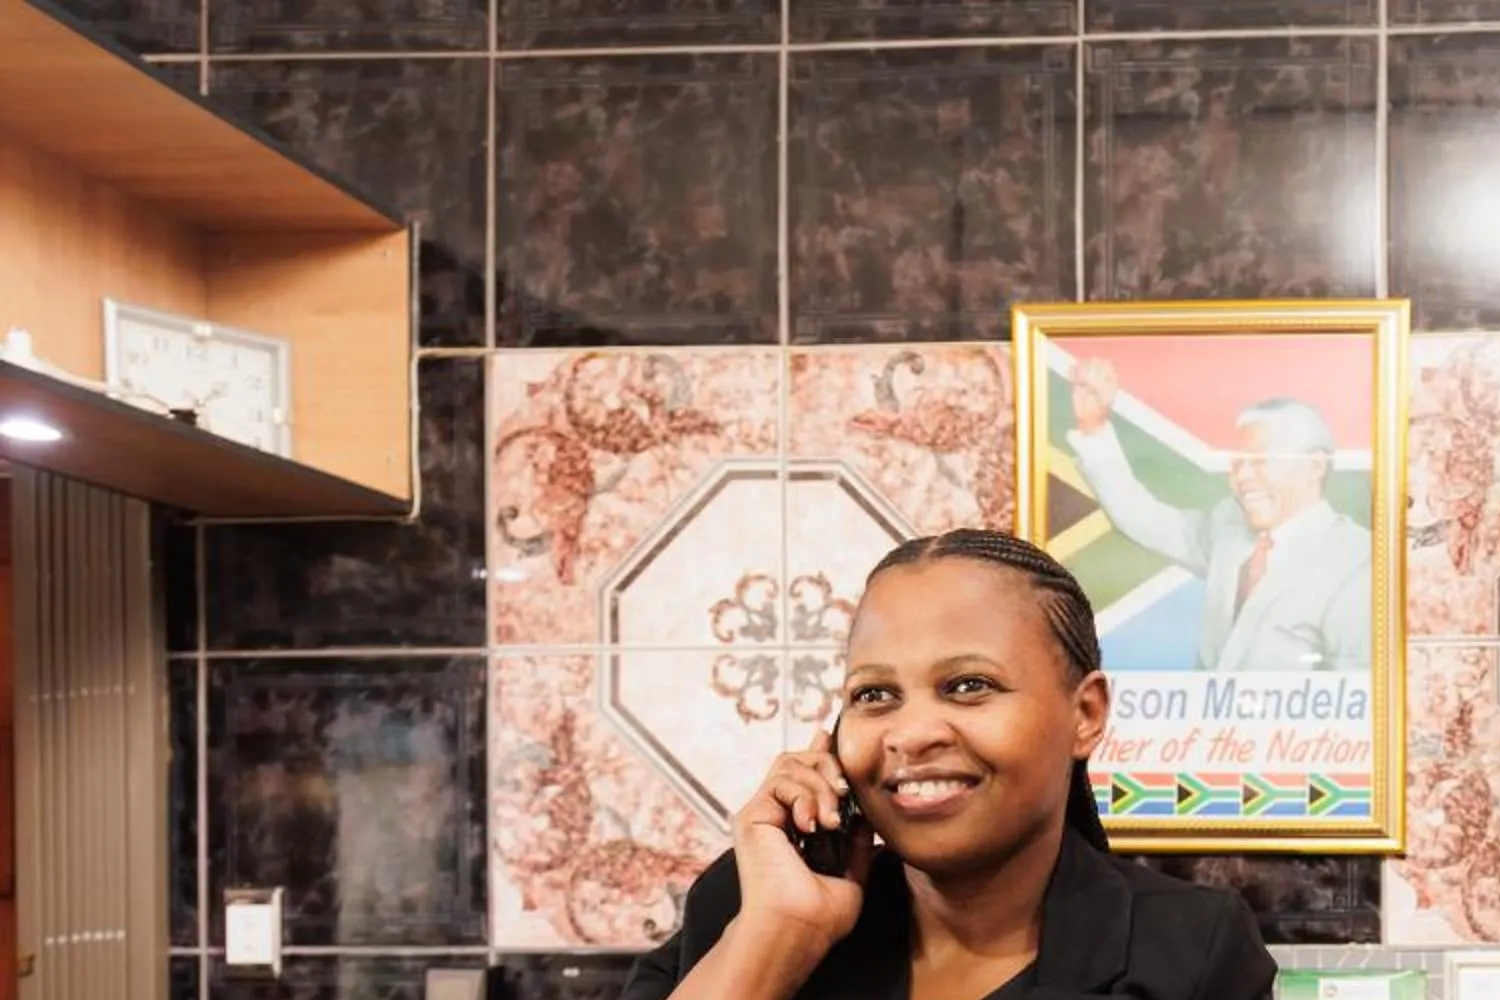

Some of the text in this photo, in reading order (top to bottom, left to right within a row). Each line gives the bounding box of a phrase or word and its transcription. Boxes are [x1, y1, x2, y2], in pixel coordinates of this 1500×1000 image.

[1202, 677, 1369, 720] Mandela
[1099, 725, 1370, 764] her of the Nation
